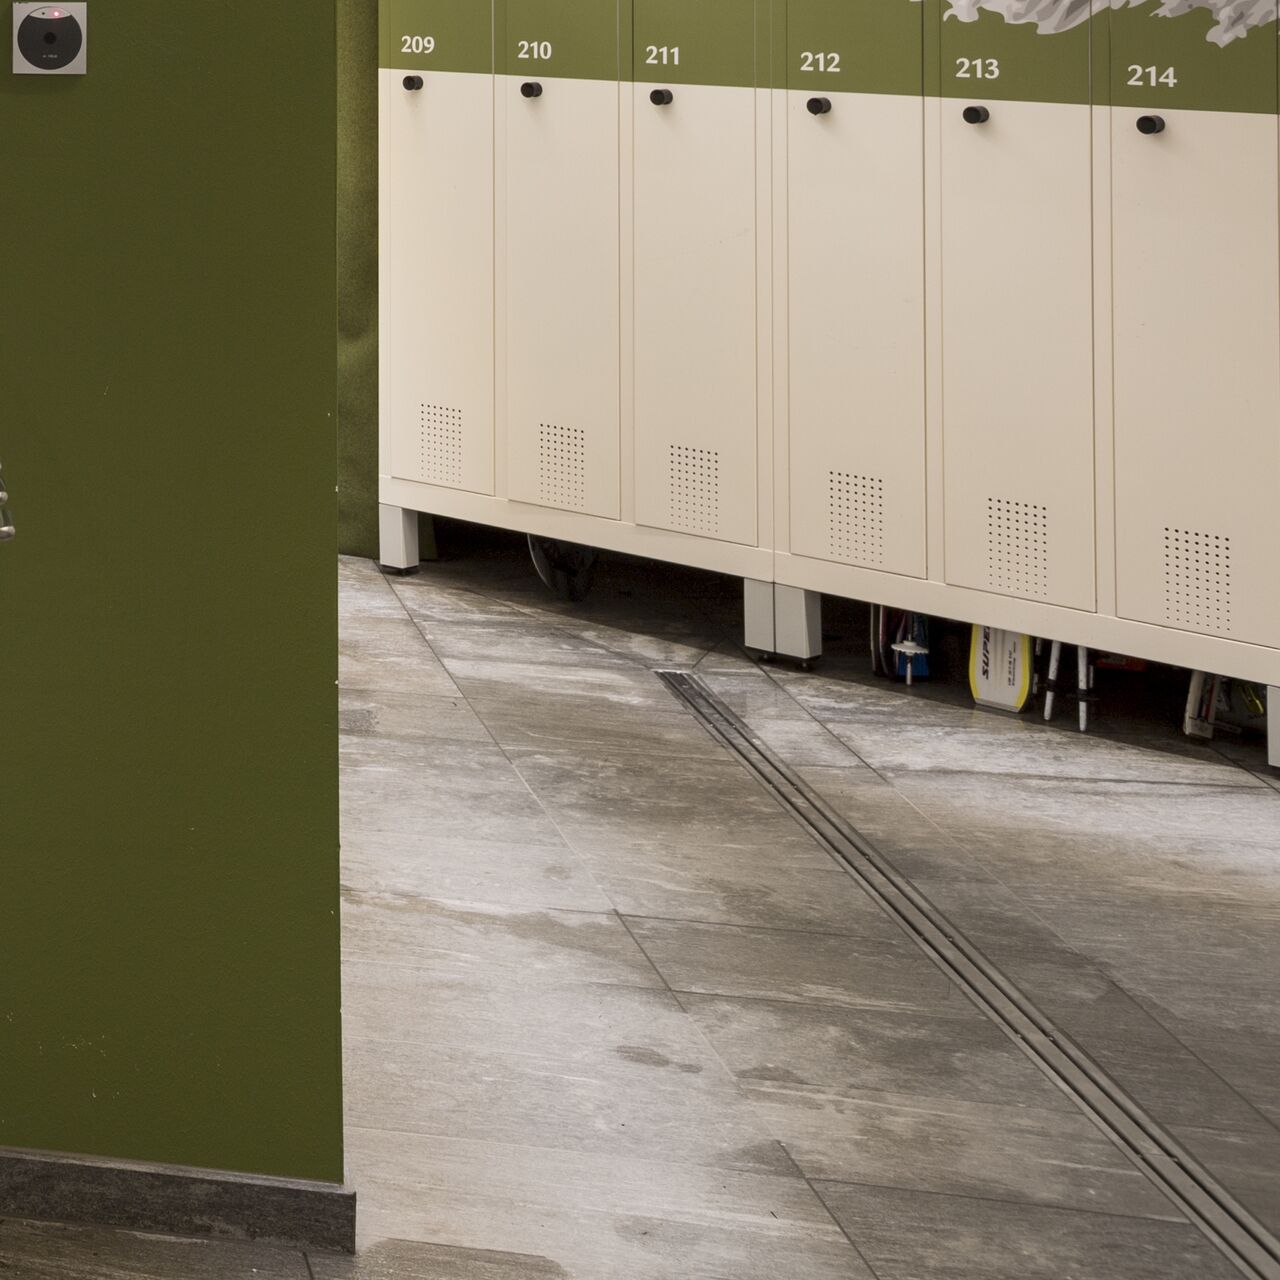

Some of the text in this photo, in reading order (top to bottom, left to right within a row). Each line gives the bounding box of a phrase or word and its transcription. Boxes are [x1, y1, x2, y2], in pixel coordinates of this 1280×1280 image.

[400, 35, 436, 54] 209
[517, 40, 553, 60] 210
[645, 45, 680, 65] 211
[800, 51, 842, 73] 212
[955, 57, 1001, 80] 213
[1126, 64, 1178, 88] 214
[982, 627, 991, 680] SUPE
